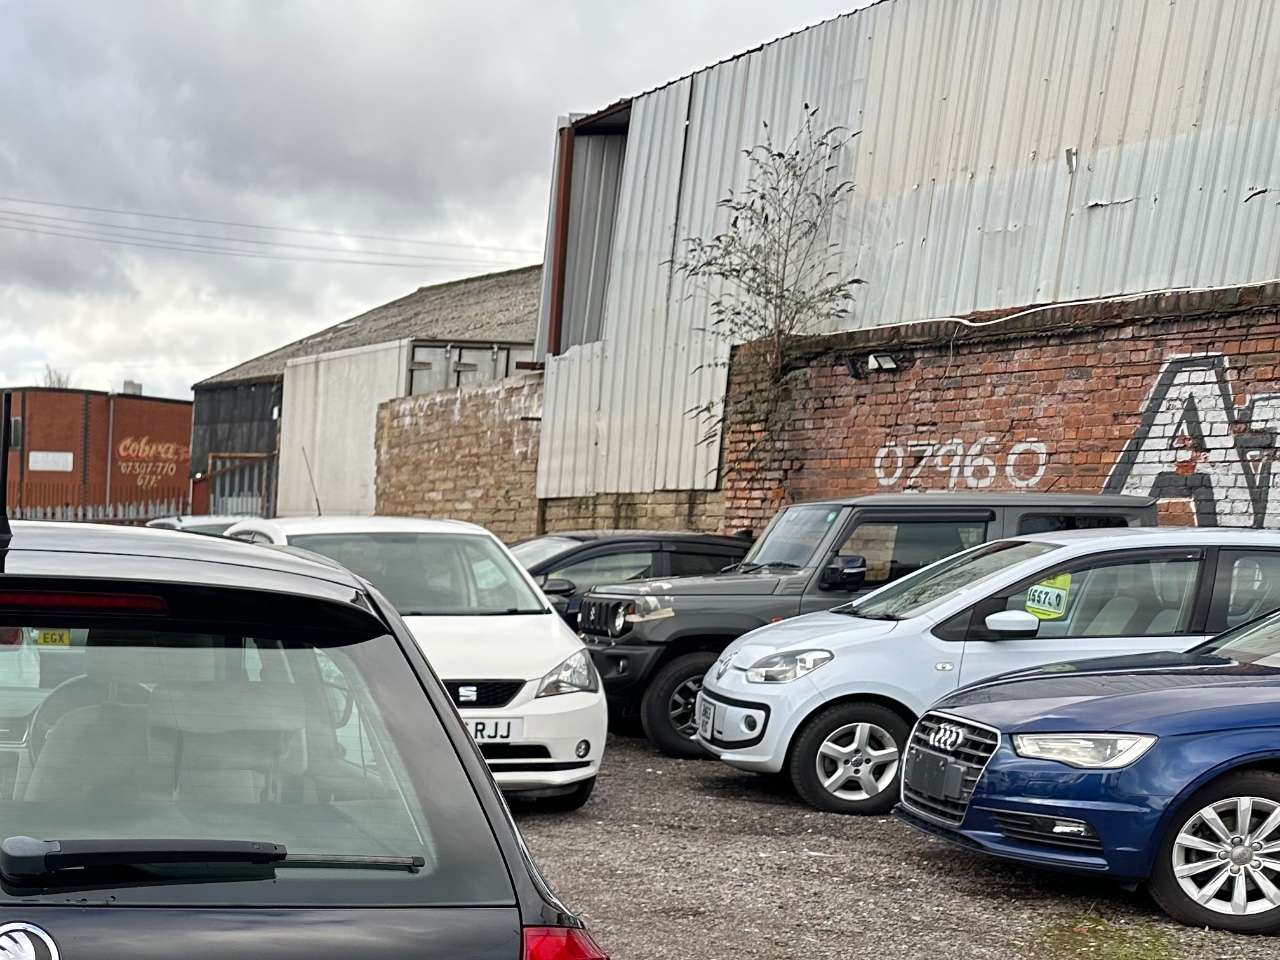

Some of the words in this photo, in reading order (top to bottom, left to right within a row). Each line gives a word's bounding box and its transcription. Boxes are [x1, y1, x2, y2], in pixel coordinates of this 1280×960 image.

[119, 436, 177, 459] Cobra
[42, 631, 65, 644] EGX
[474, 721, 512, 739] RJJ
